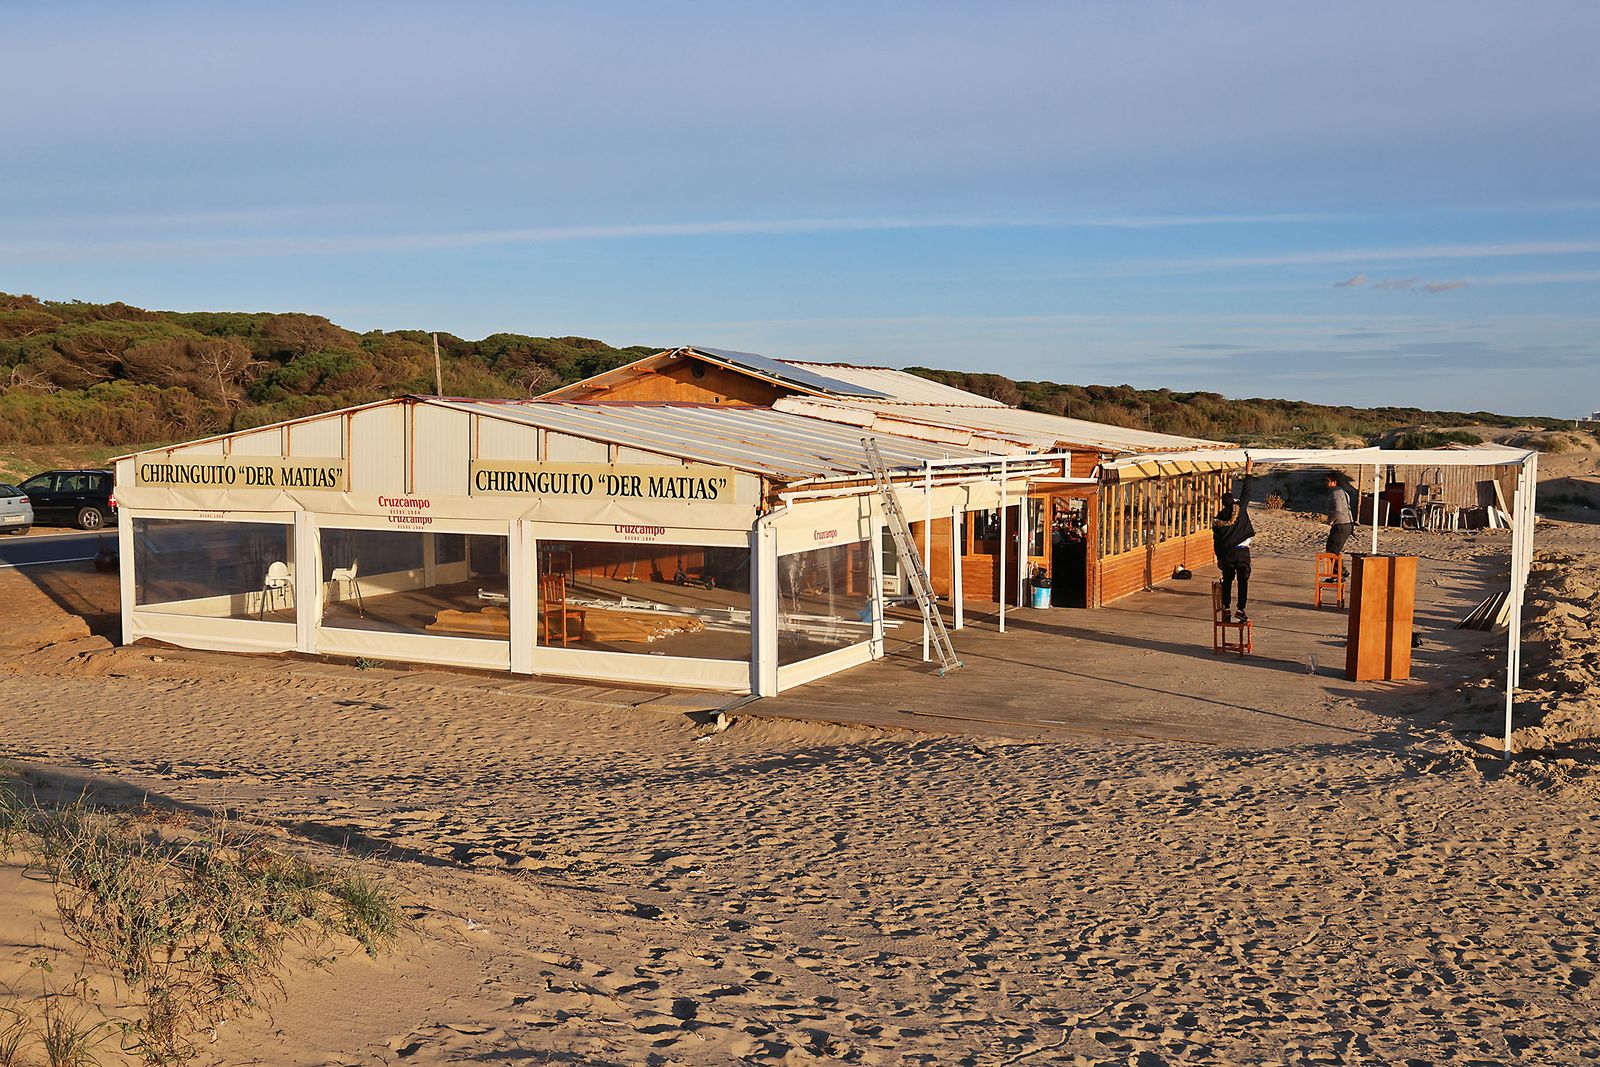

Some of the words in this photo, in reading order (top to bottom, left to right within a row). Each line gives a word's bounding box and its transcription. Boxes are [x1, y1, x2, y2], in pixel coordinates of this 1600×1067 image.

[141, 463, 236, 485] CHIRINGUITO
[239, 465, 275, 486] “DER
[281, 467, 342, 488] MATIAS”
[475, 469, 593, 495] CHIRINGUITO
[598, 474, 643, 497] “DER
[648, 476, 726, 500] MATIAS”
[378, 495, 431, 510] Cruzcampo
